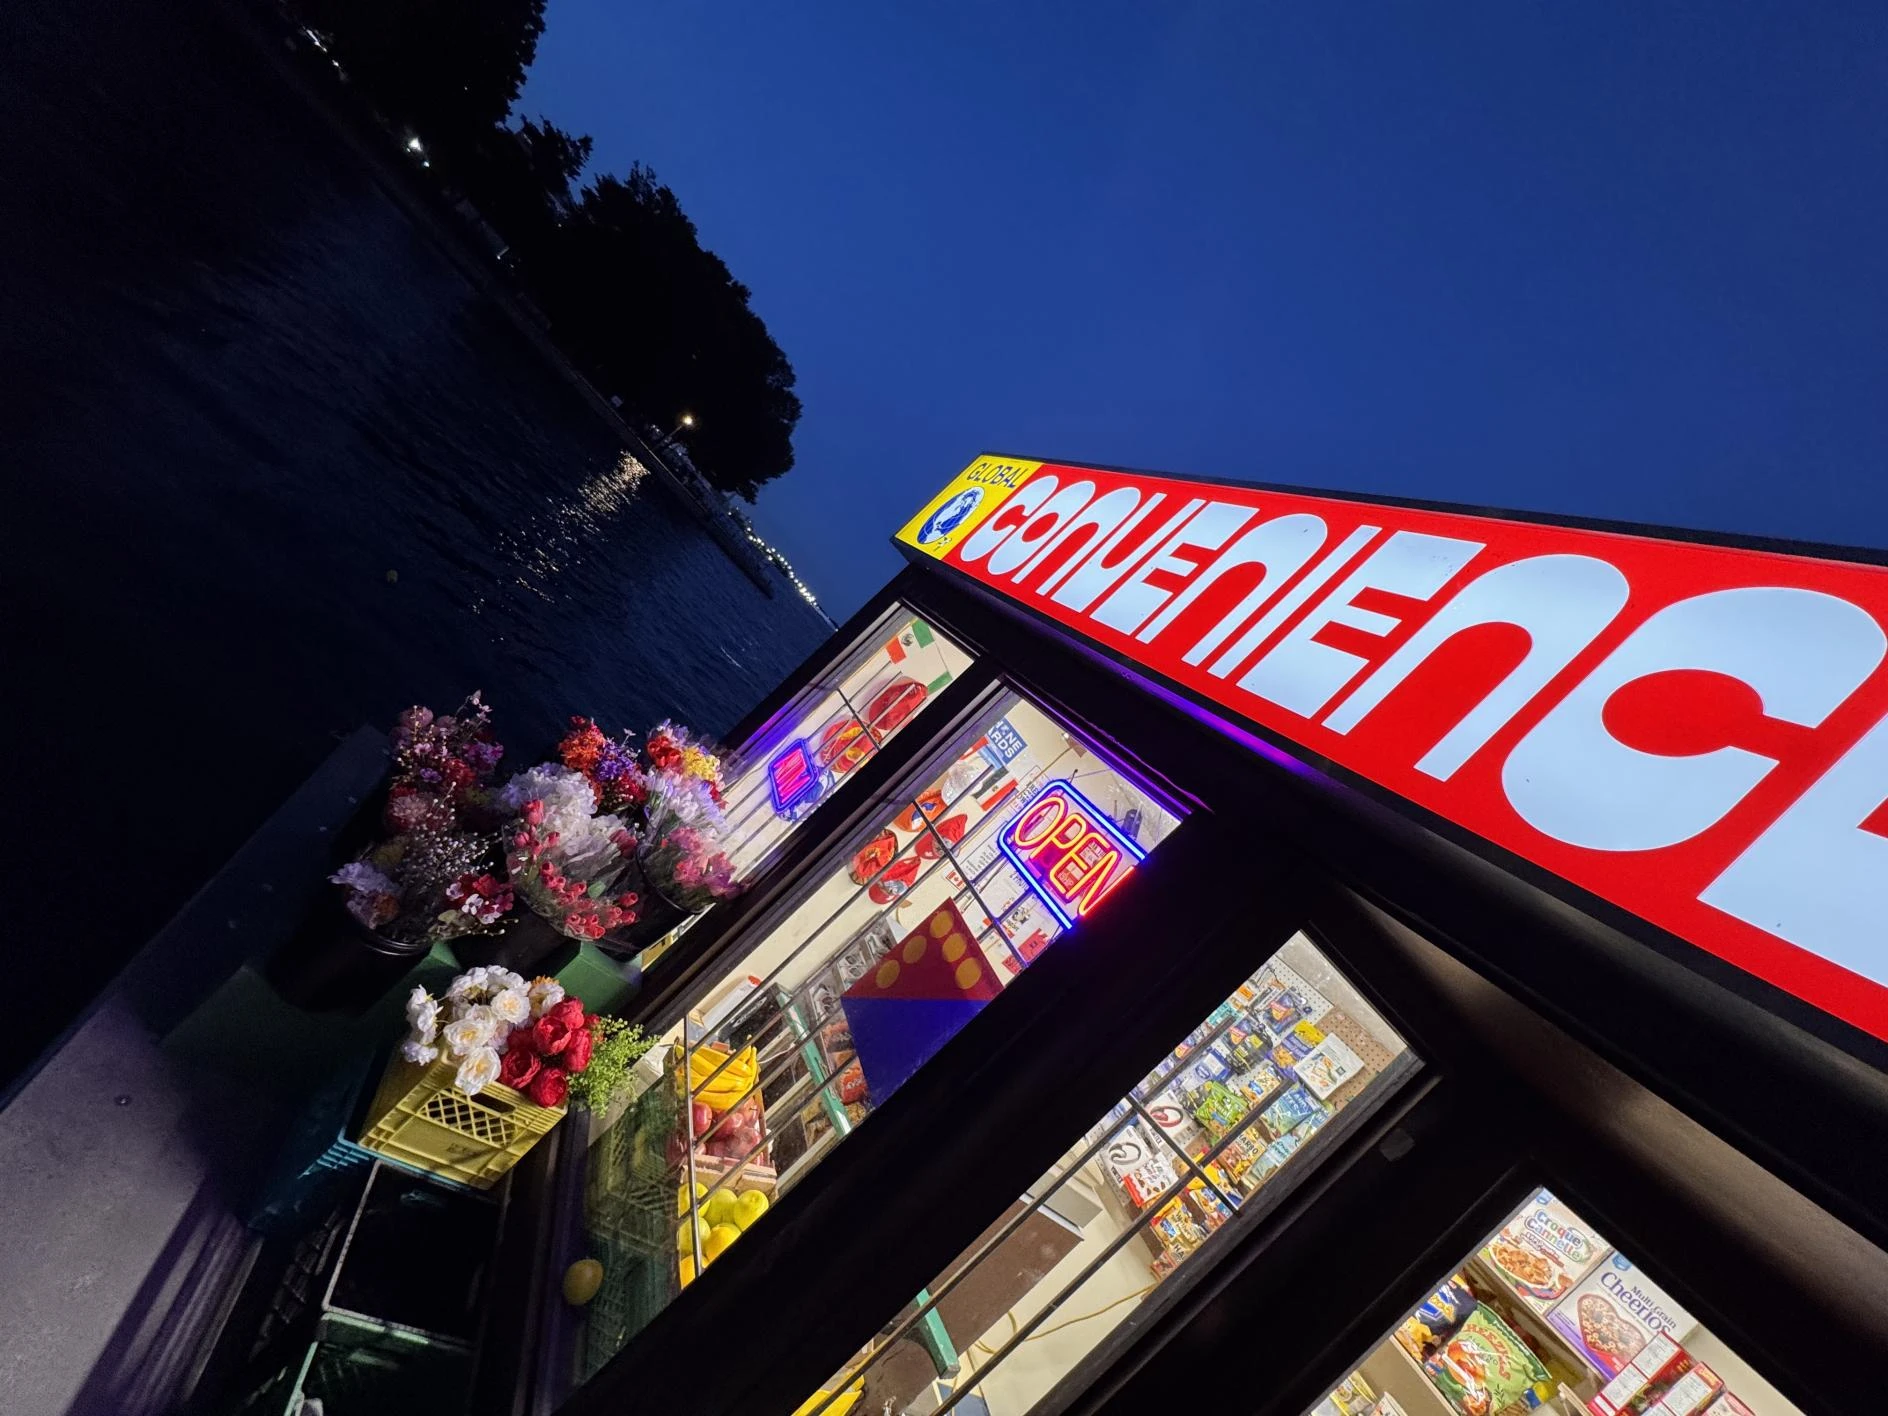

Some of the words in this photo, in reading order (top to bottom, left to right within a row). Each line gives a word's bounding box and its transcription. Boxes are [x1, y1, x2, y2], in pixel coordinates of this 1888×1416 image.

[967, 462, 1028, 488] GLOBAL
[1014, 796, 1136, 916] OPEN
[1526, 1217, 1581, 1261] Cannelle
[1536, 1210, 1583, 1248] Croque
[1600, 1271, 1671, 1334] Cheerios
[1630, 1285, 1653, 1308] Multi
[1650, 1304, 1678, 1330] Grain
